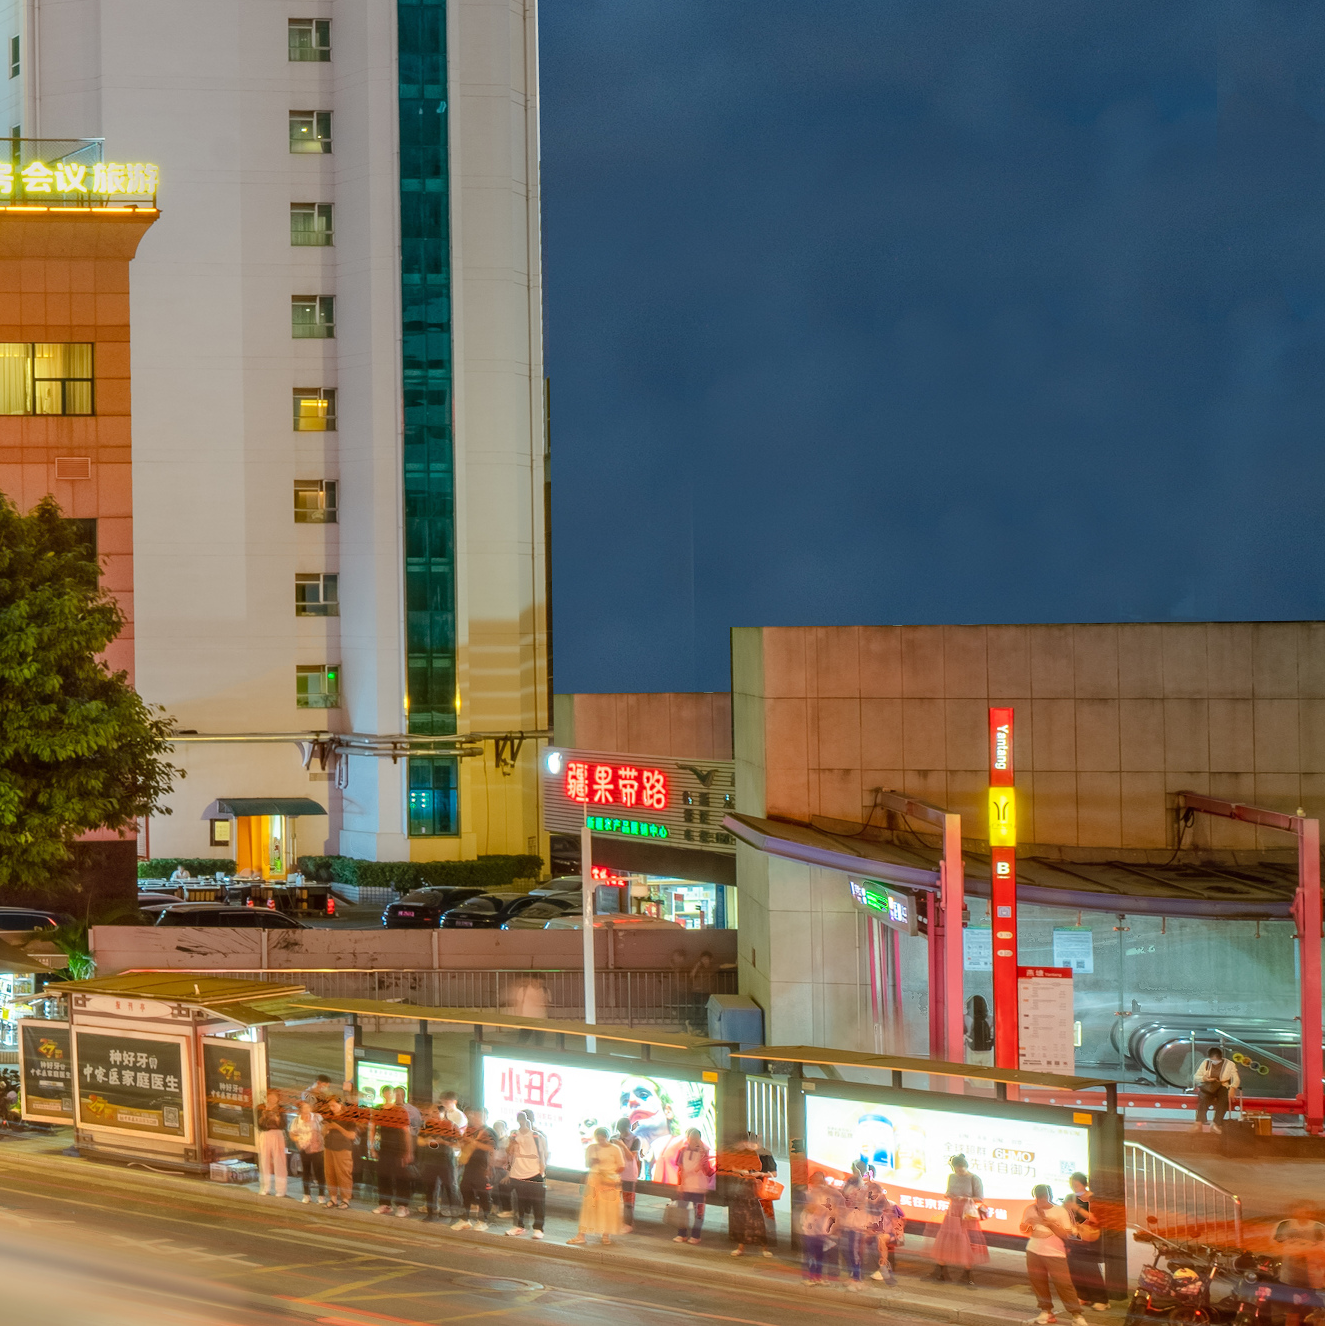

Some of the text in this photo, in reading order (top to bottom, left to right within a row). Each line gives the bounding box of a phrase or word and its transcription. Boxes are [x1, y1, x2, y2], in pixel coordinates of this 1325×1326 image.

[21, 161, 87, 193] 会议
[92, 161, 160, 194] 旅游
[995, 724, 1009, 770] Yantang
[997, 861, 1010, 874] B
[109, 1049, 148, 1068] 种好牙
[500, 1067, 563, 1108] 小丑2
[993, 1148, 1034, 1163] 6HMO
